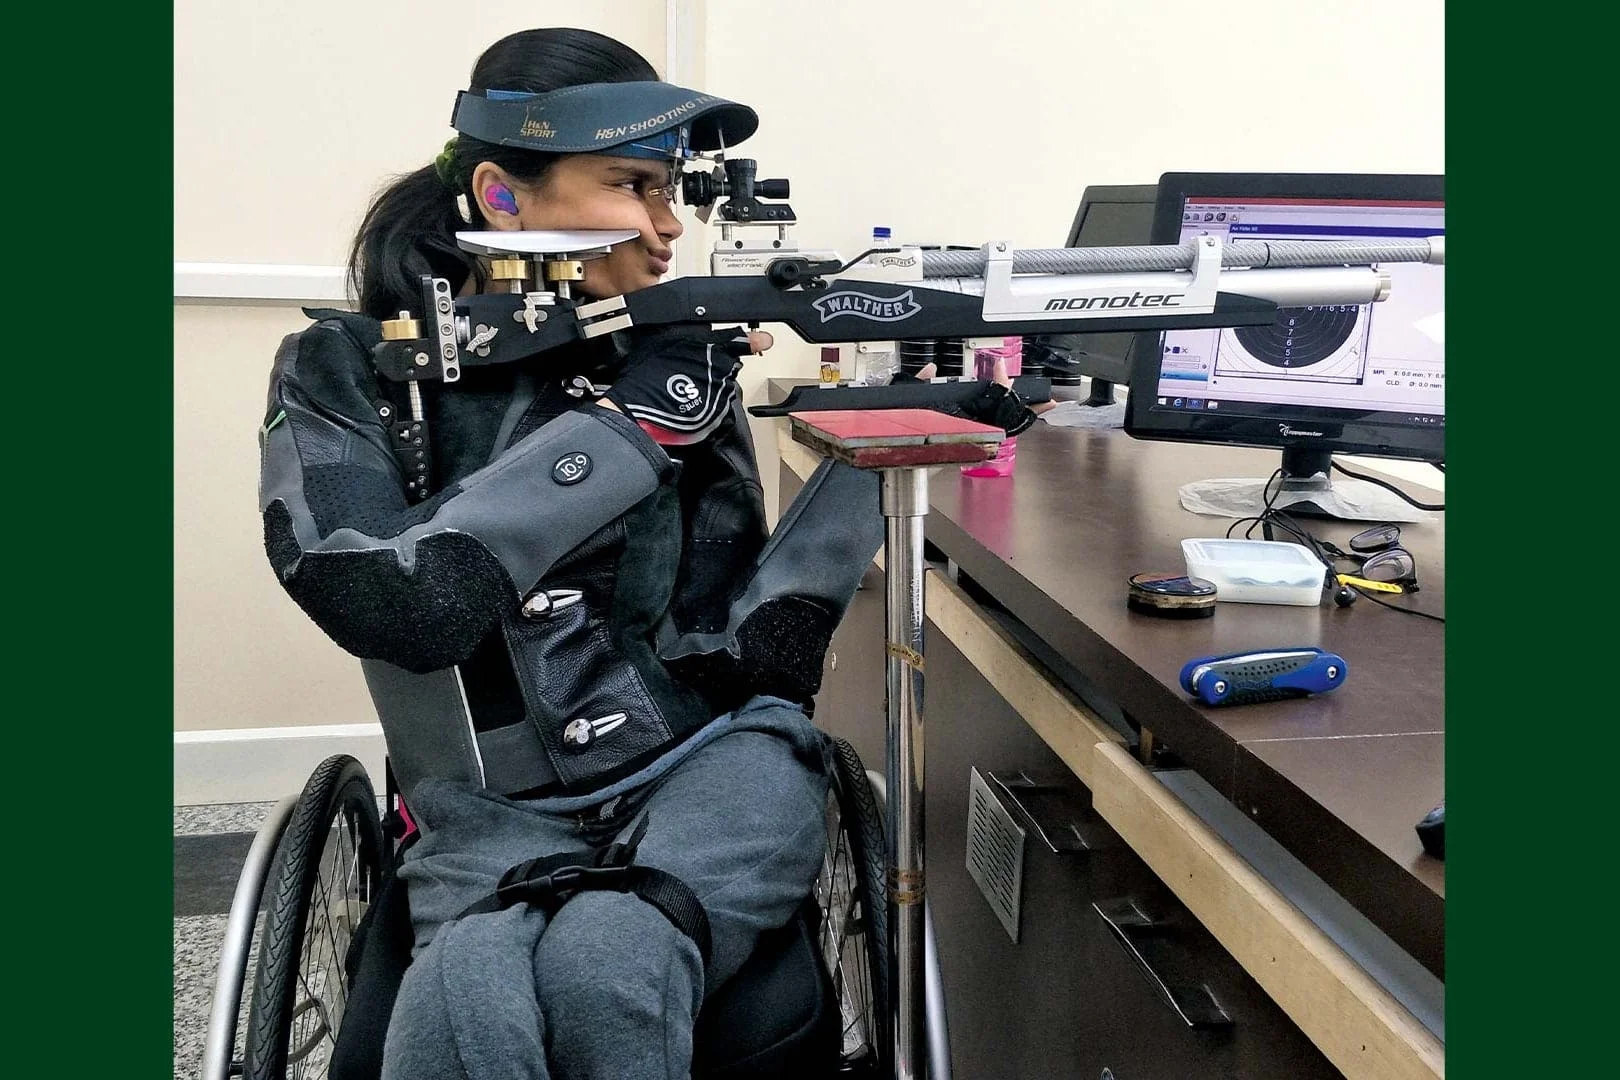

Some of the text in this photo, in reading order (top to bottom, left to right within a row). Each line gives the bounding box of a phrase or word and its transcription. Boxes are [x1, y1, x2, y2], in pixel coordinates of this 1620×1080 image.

[594, 126, 627, 140] H&N
[629, 101, 696, 133] SHOOTING
[520, 128, 557, 138] SPORT
[826, 296, 905, 317] WALTHER
[1044, 291, 1185, 311] monotec
[679, 396, 703, 413] Sauer
[560, 454, 587, 477] 10.9
